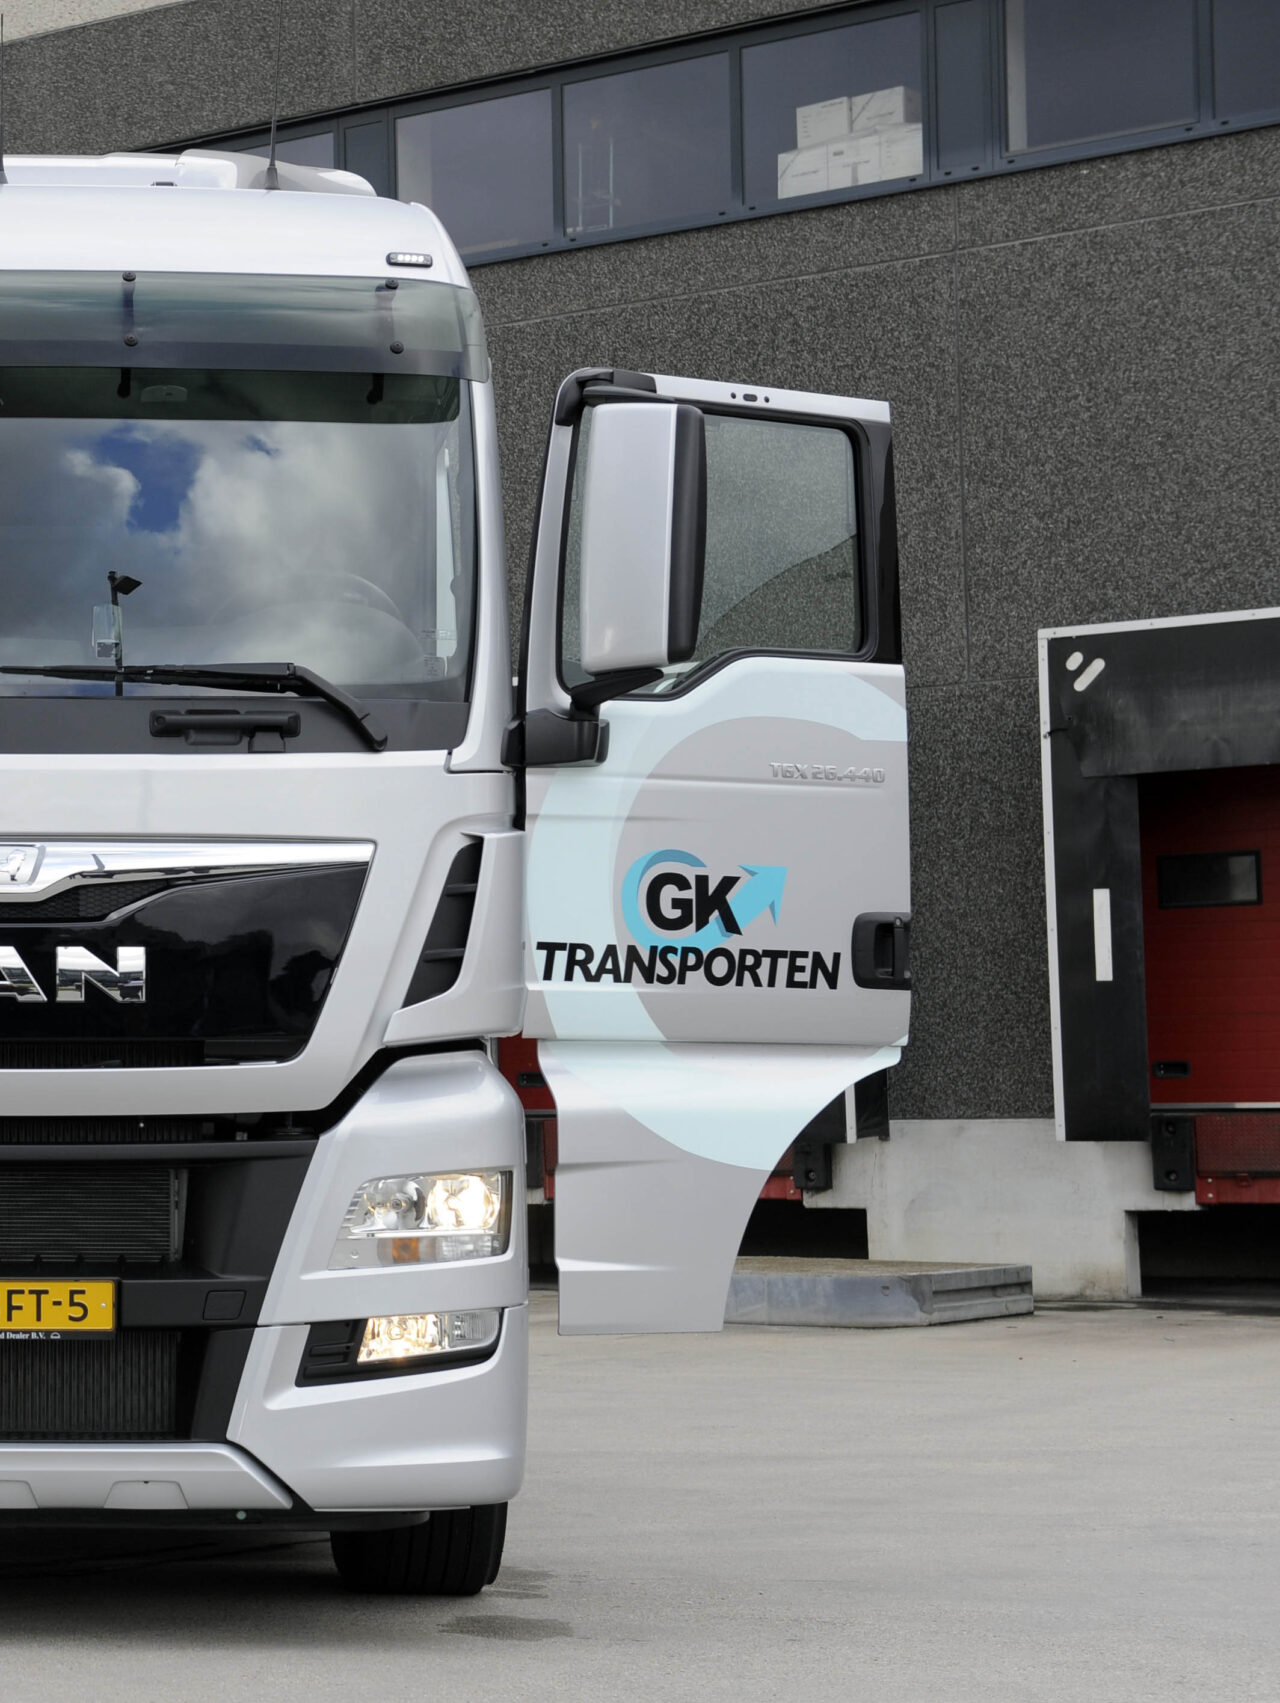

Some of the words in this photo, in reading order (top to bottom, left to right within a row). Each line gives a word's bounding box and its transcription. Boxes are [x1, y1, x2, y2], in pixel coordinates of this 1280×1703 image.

[769, 762, 808, 779] TGX
[811, 765, 885, 783] 26.440
[646, 872, 743, 936] GK
[536, 942, 841, 990] TRANSPORTEN
[6, 1331, 30, 1340] Dealer
[31, 1331, 46, 1340] B.V.
